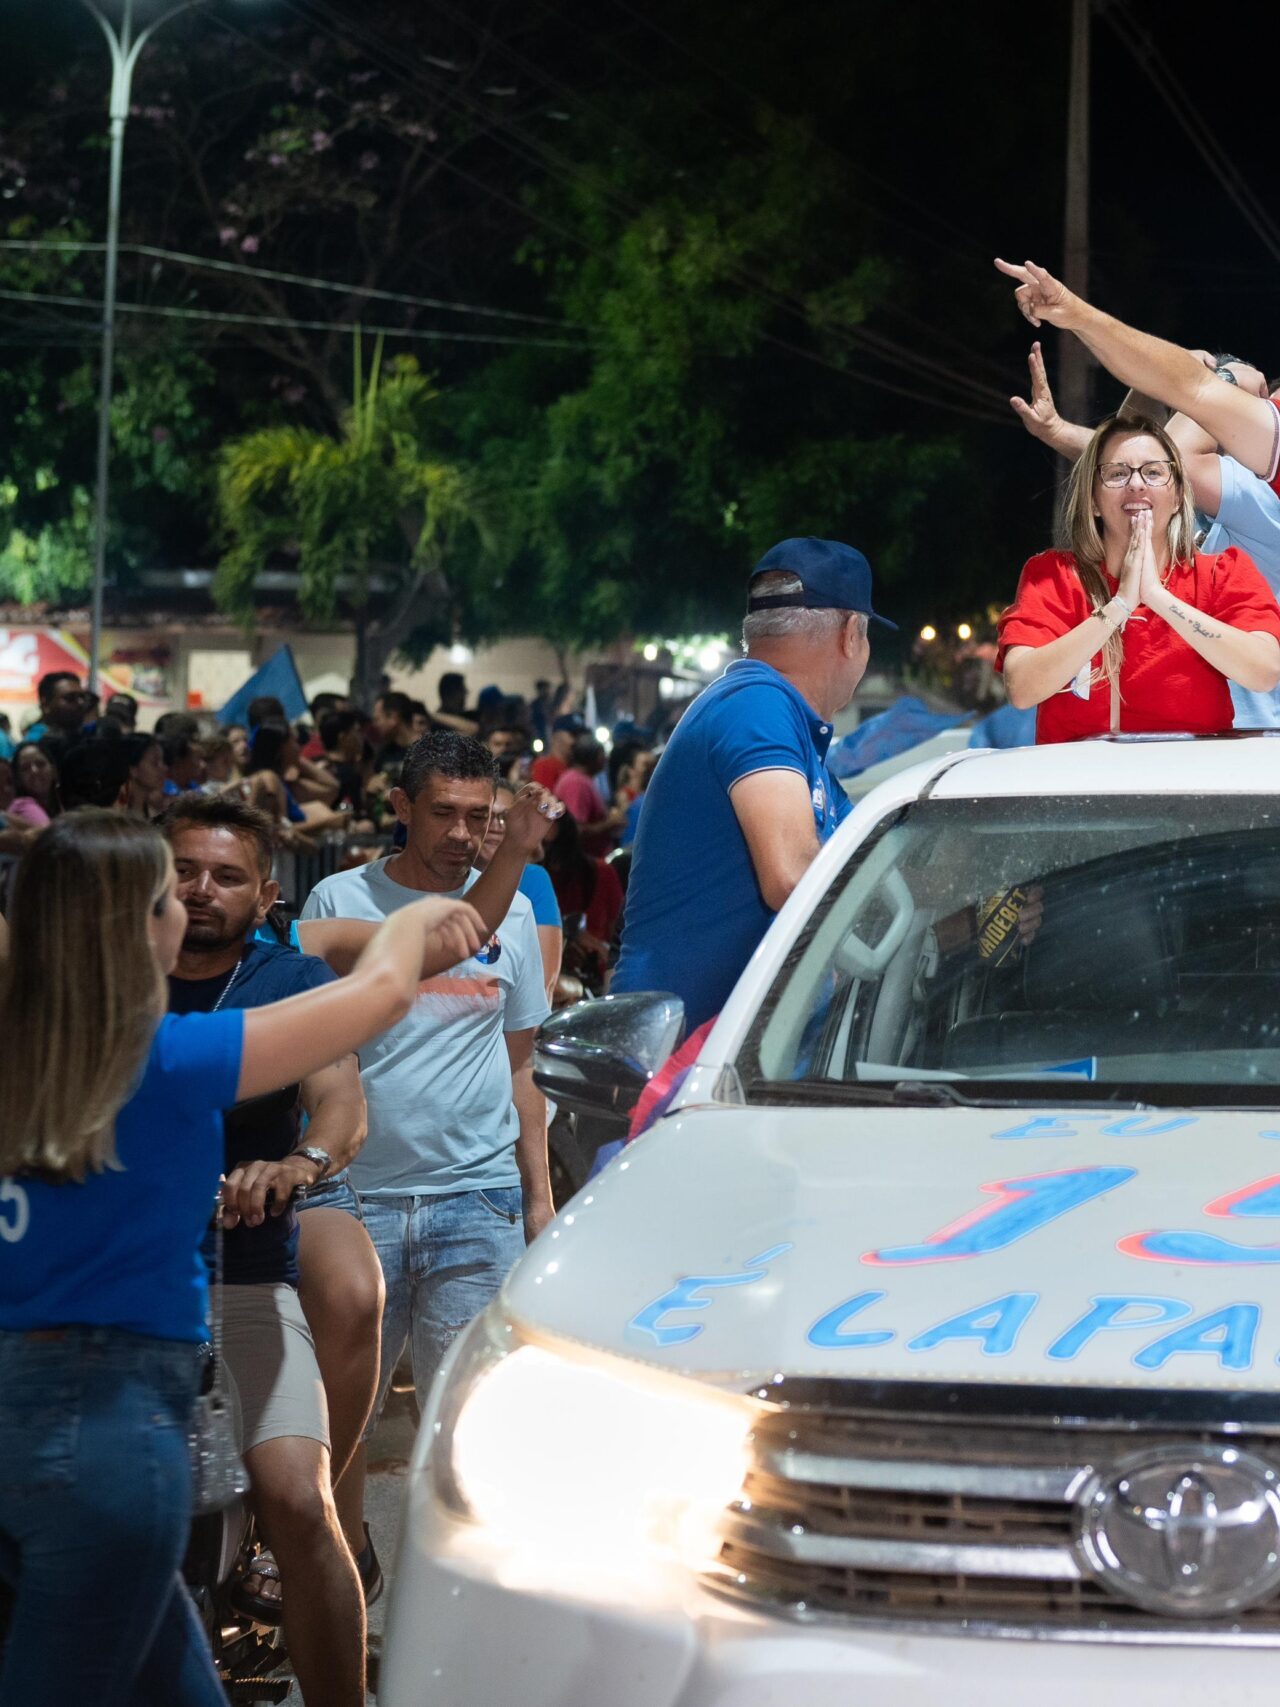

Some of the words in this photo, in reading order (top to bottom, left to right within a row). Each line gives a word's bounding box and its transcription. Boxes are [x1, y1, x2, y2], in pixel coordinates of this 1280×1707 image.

[980, 887, 1027, 958] VAIDEBET
[992, 1114, 1199, 1140] EU
[623, 1241, 793, 1347] É
